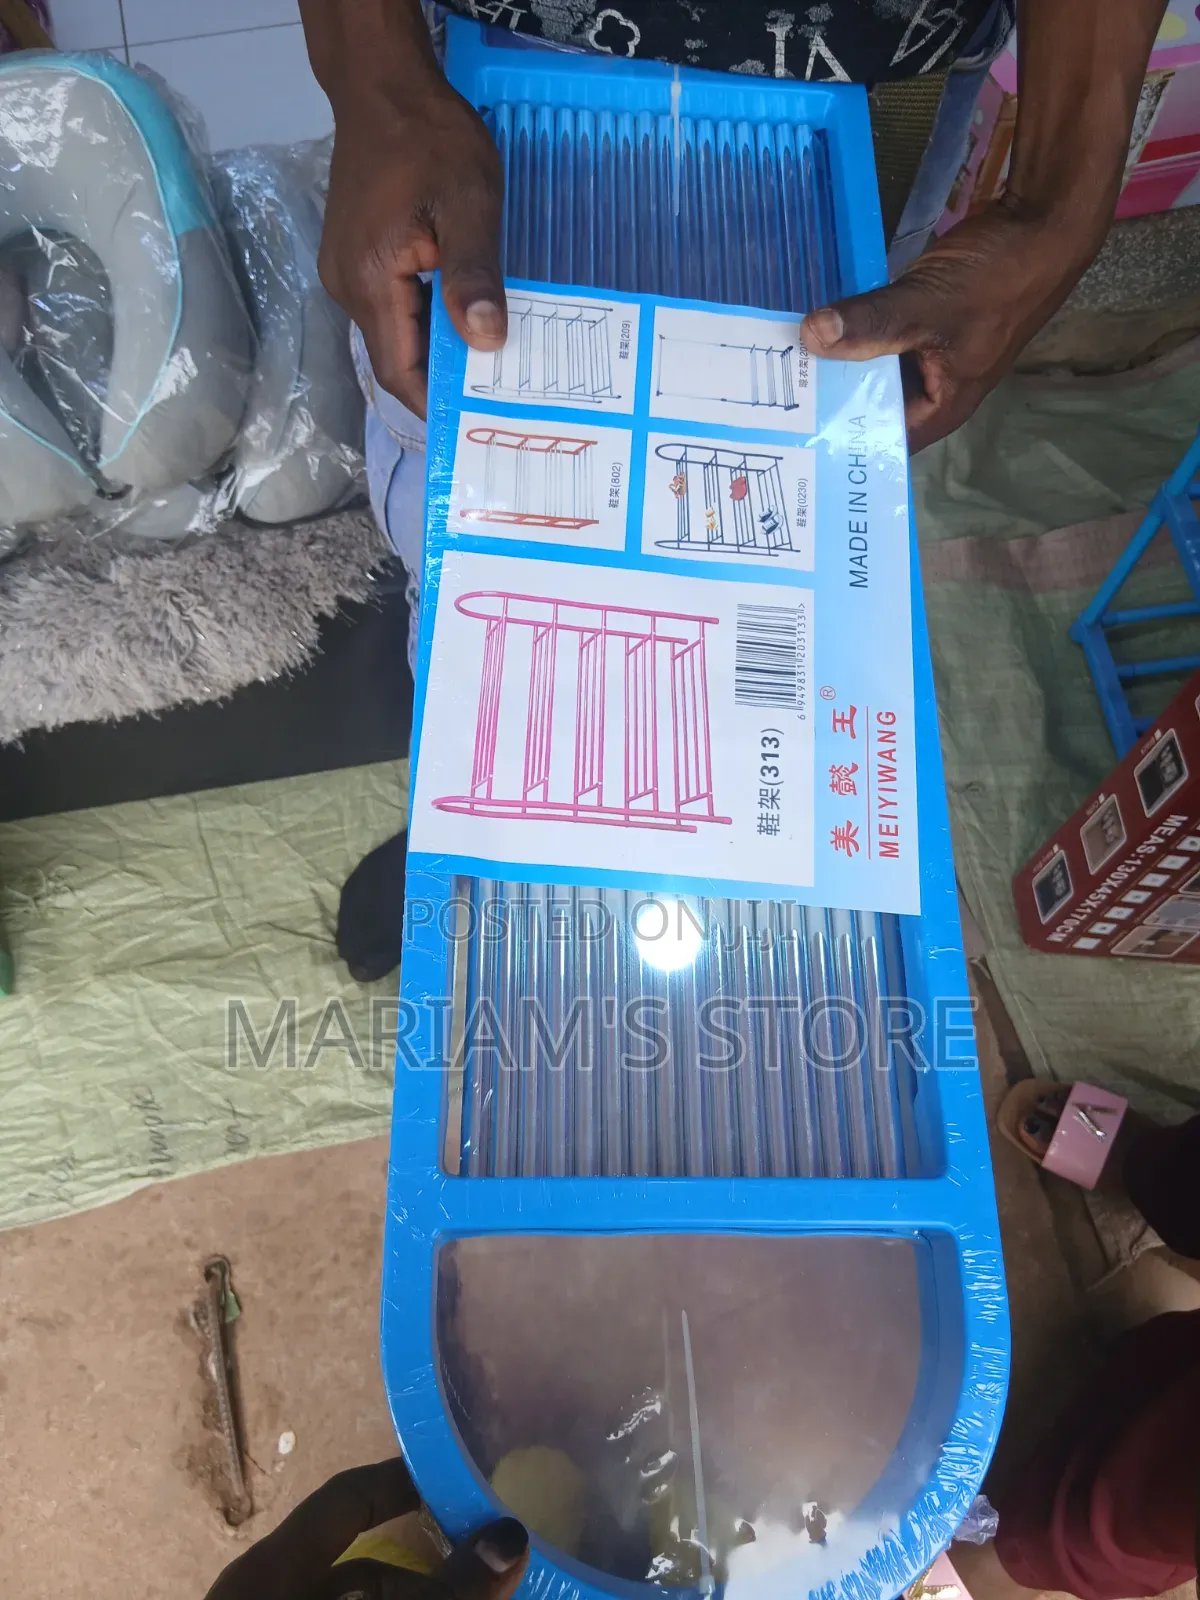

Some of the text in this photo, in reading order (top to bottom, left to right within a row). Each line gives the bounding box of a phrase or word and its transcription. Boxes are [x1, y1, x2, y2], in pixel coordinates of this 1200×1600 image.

[608, 462, 623, 509] 鞋架(802)
[796, 478, 809, 528] 鞋架(0230)
[848, 415, 868, 588] MADE IN CHINA
[757, 728, 784, 836] 鞋架(313)
[876, 711, 899, 859] MEIYIWANG
